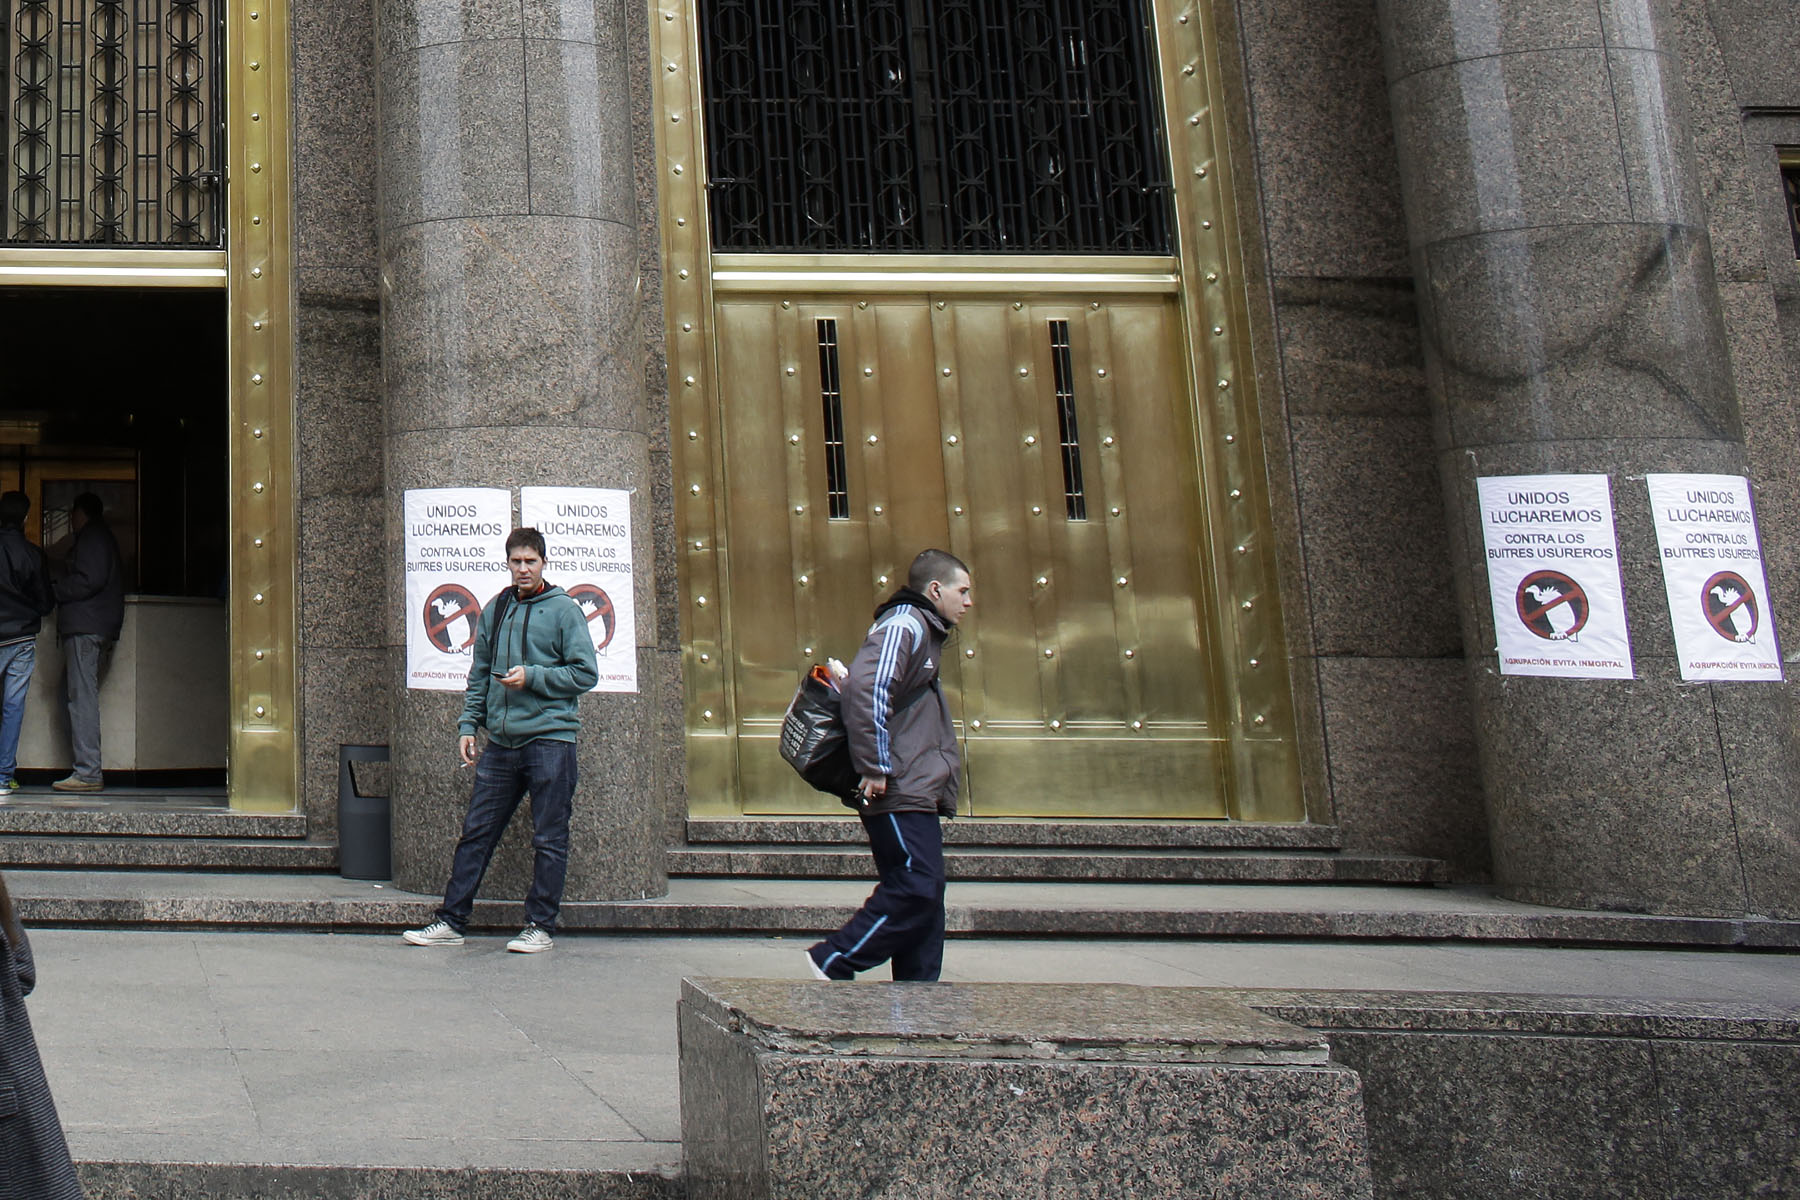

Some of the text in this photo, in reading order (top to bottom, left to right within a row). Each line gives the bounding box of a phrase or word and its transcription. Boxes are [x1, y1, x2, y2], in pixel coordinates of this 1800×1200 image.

[1508, 492, 1570, 505] UNIDOS
[1687, 491, 1735, 504] UNIDOS
[426, 505, 477, 518] UNIDOS
[556, 504, 608, 518] UNIDOS
[1491, 510, 1602, 523] LUCHAREMOS
[1668, 509, 1751, 523] LUCHAREMOS
[412, 523, 502, 536] LUCHAREMOS
[536, 522, 626, 537] LUCHAREMOS
[1505, 534, 1585, 544] CONTRA LOS
[1686, 533, 1747, 545] CONTRA LOS
[420, 547, 486, 557] CONTRA LOS
[549, 547, 616, 558] CONTRA LOS
[1488, 548, 1613, 558] BUITRES USUREROS
[1664, 548, 1760, 560] BUITRES USUREROS
[407, 561, 508, 572] BUITRES USUREROS
[544, 561, 631, 573] TRES USUREROS
[1579, 660, 1624, 668] INMORTAL
